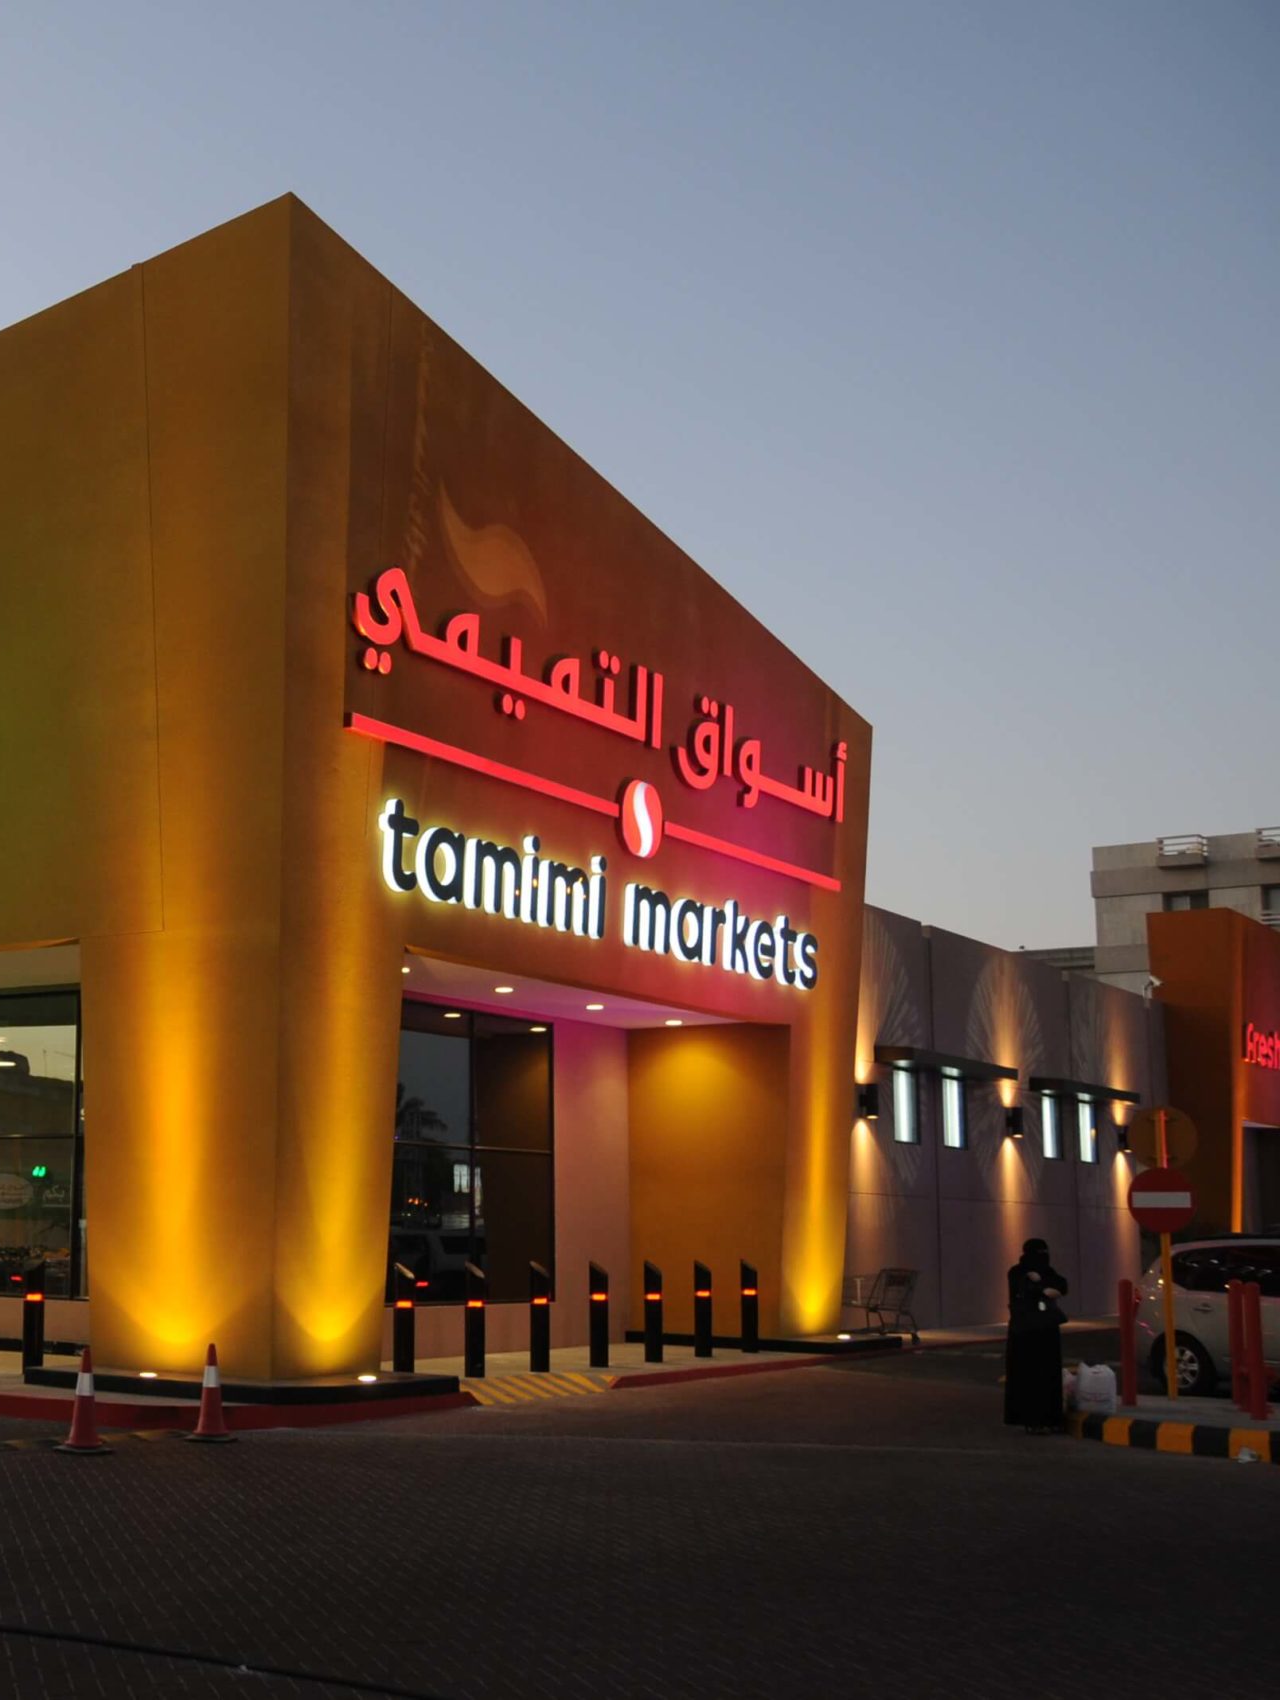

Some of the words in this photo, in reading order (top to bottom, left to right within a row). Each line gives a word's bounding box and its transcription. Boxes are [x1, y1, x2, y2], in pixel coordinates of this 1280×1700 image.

[352, 566, 664, 749] التميمي
[671, 694, 848, 823] أسواق
[379, 797, 607, 940] tamimi
[623, 879, 819, 990] markets
